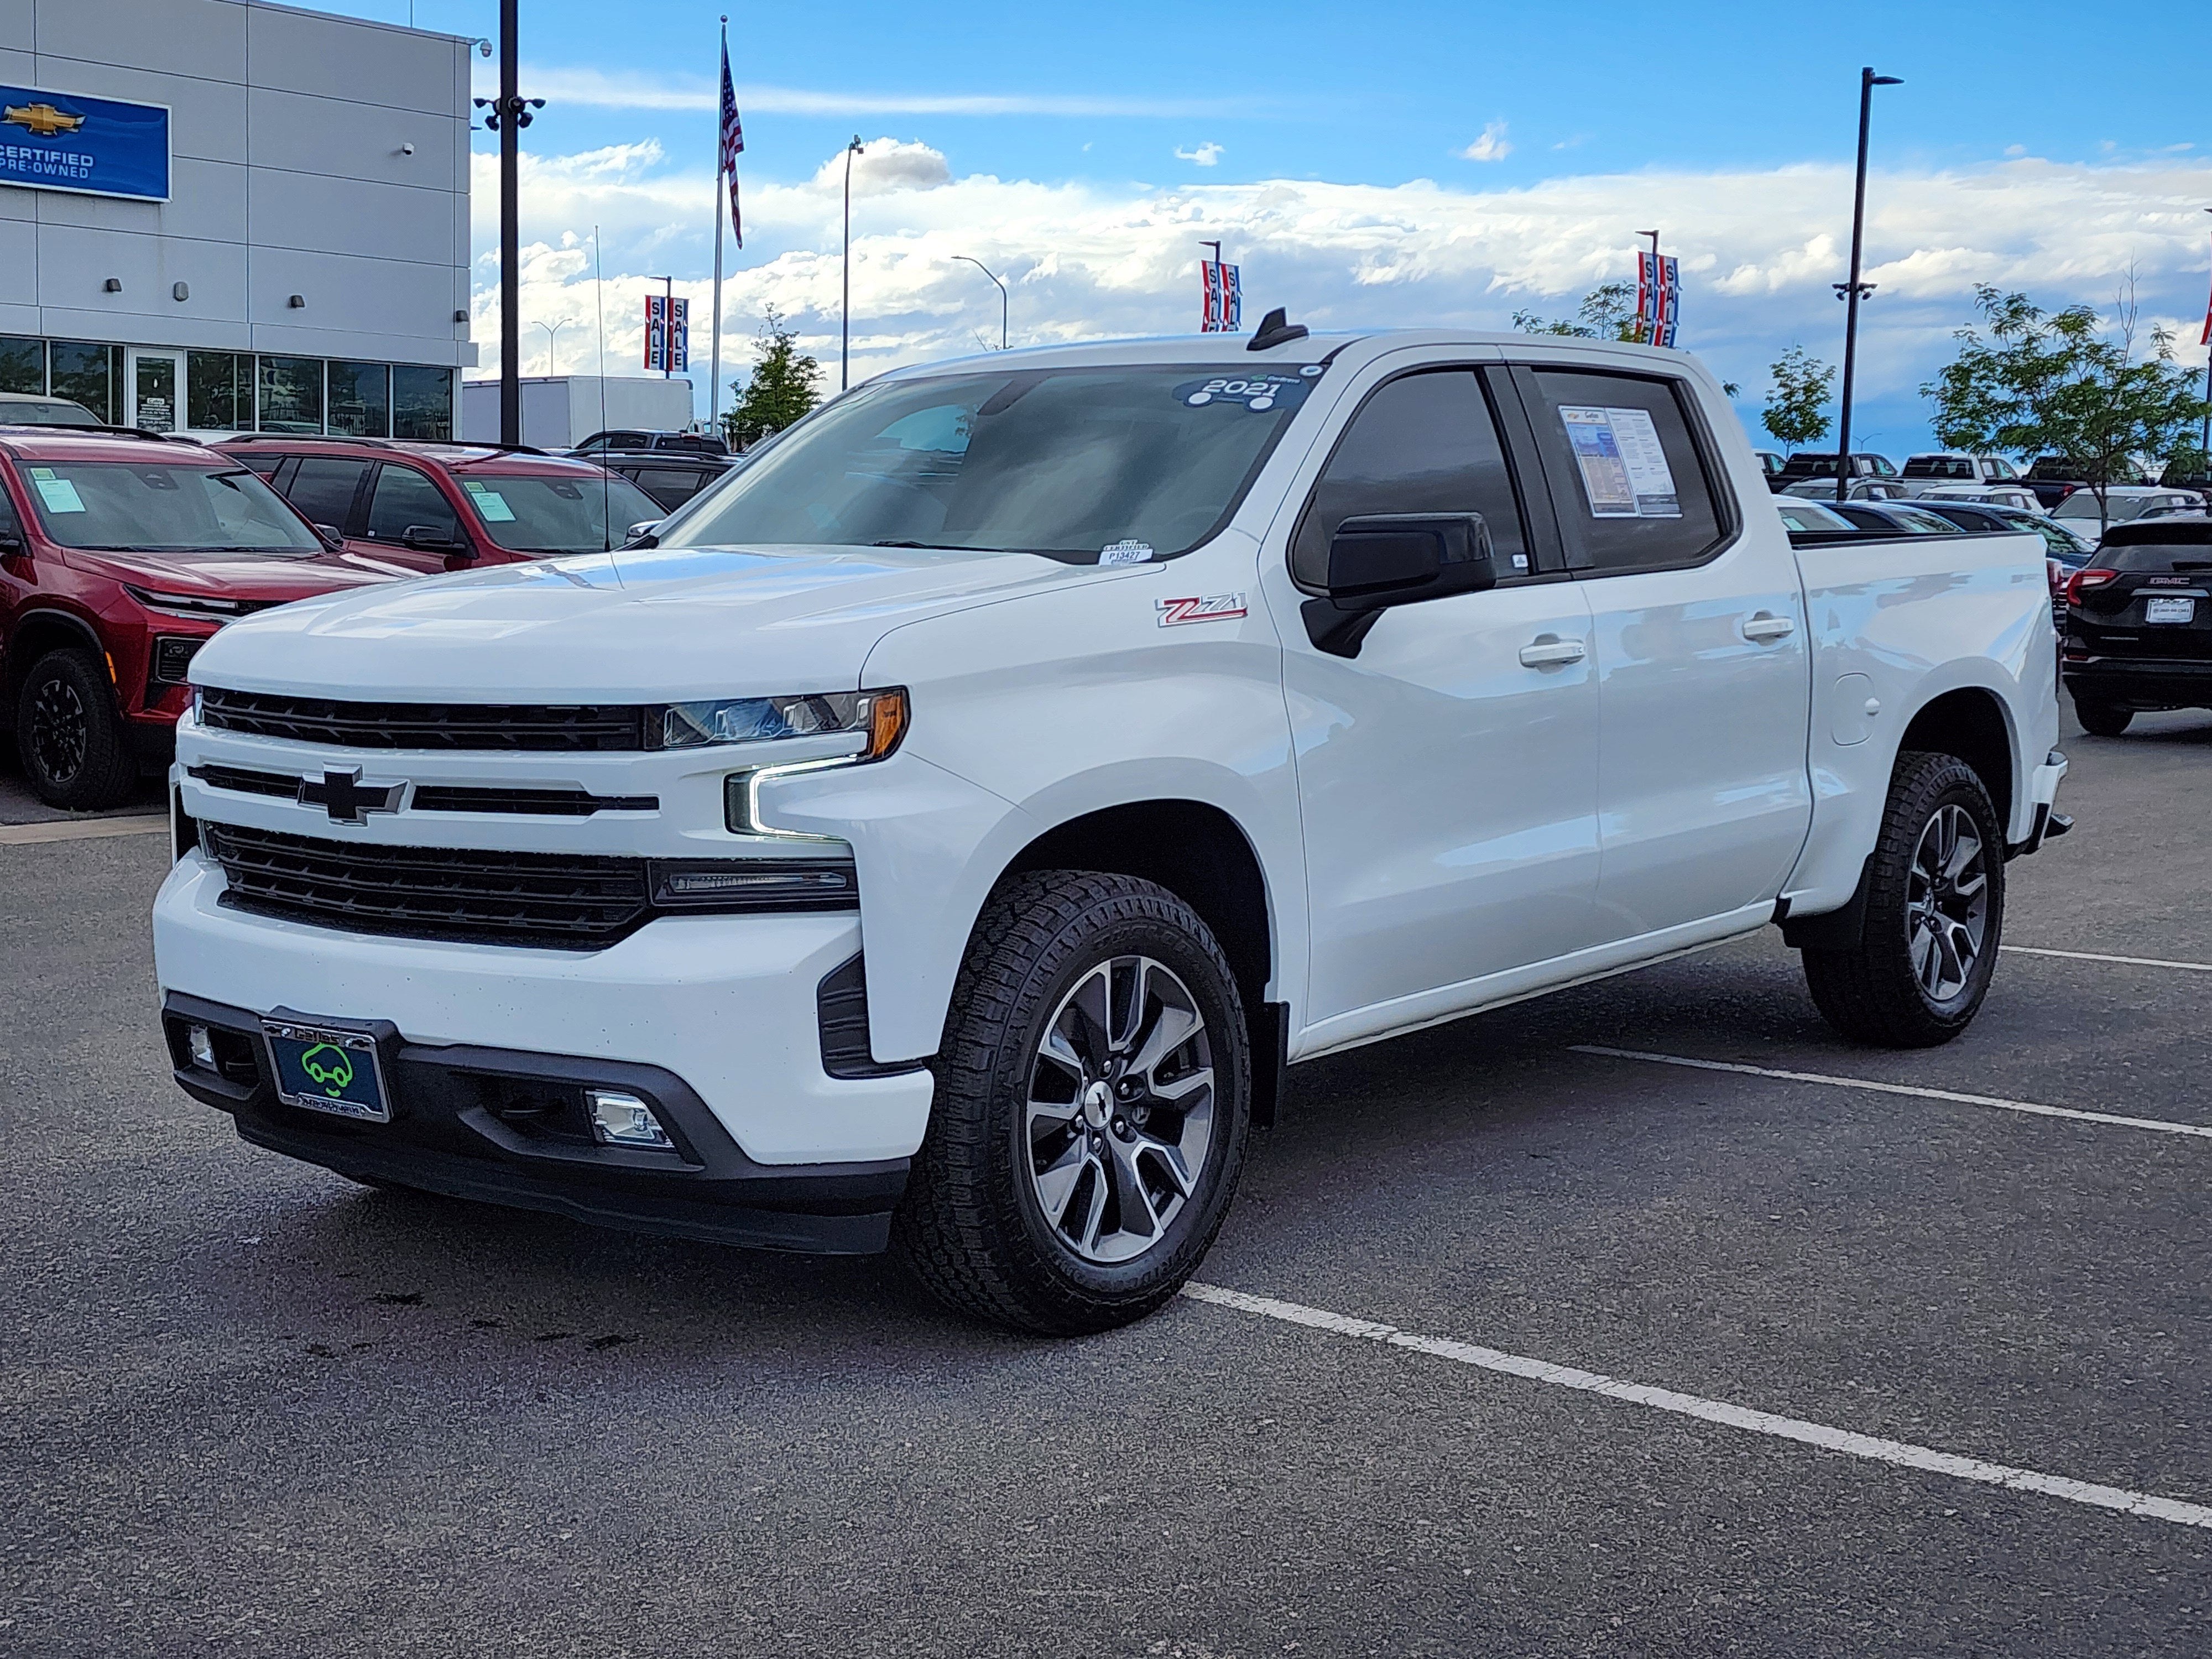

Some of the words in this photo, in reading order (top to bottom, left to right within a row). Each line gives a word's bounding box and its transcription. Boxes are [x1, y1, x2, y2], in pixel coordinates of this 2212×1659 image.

[1228, 272, 1237, 332] SAL
[1662, 264, 1674, 346] SALE
[651, 302, 660, 364] SALE
[674, 304, 682, 366] SALE
[1201, 379, 1281, 397] 2021
[1109, 551, 1141, 561] P13427
[1155, 591, 1249, 628] Z71
